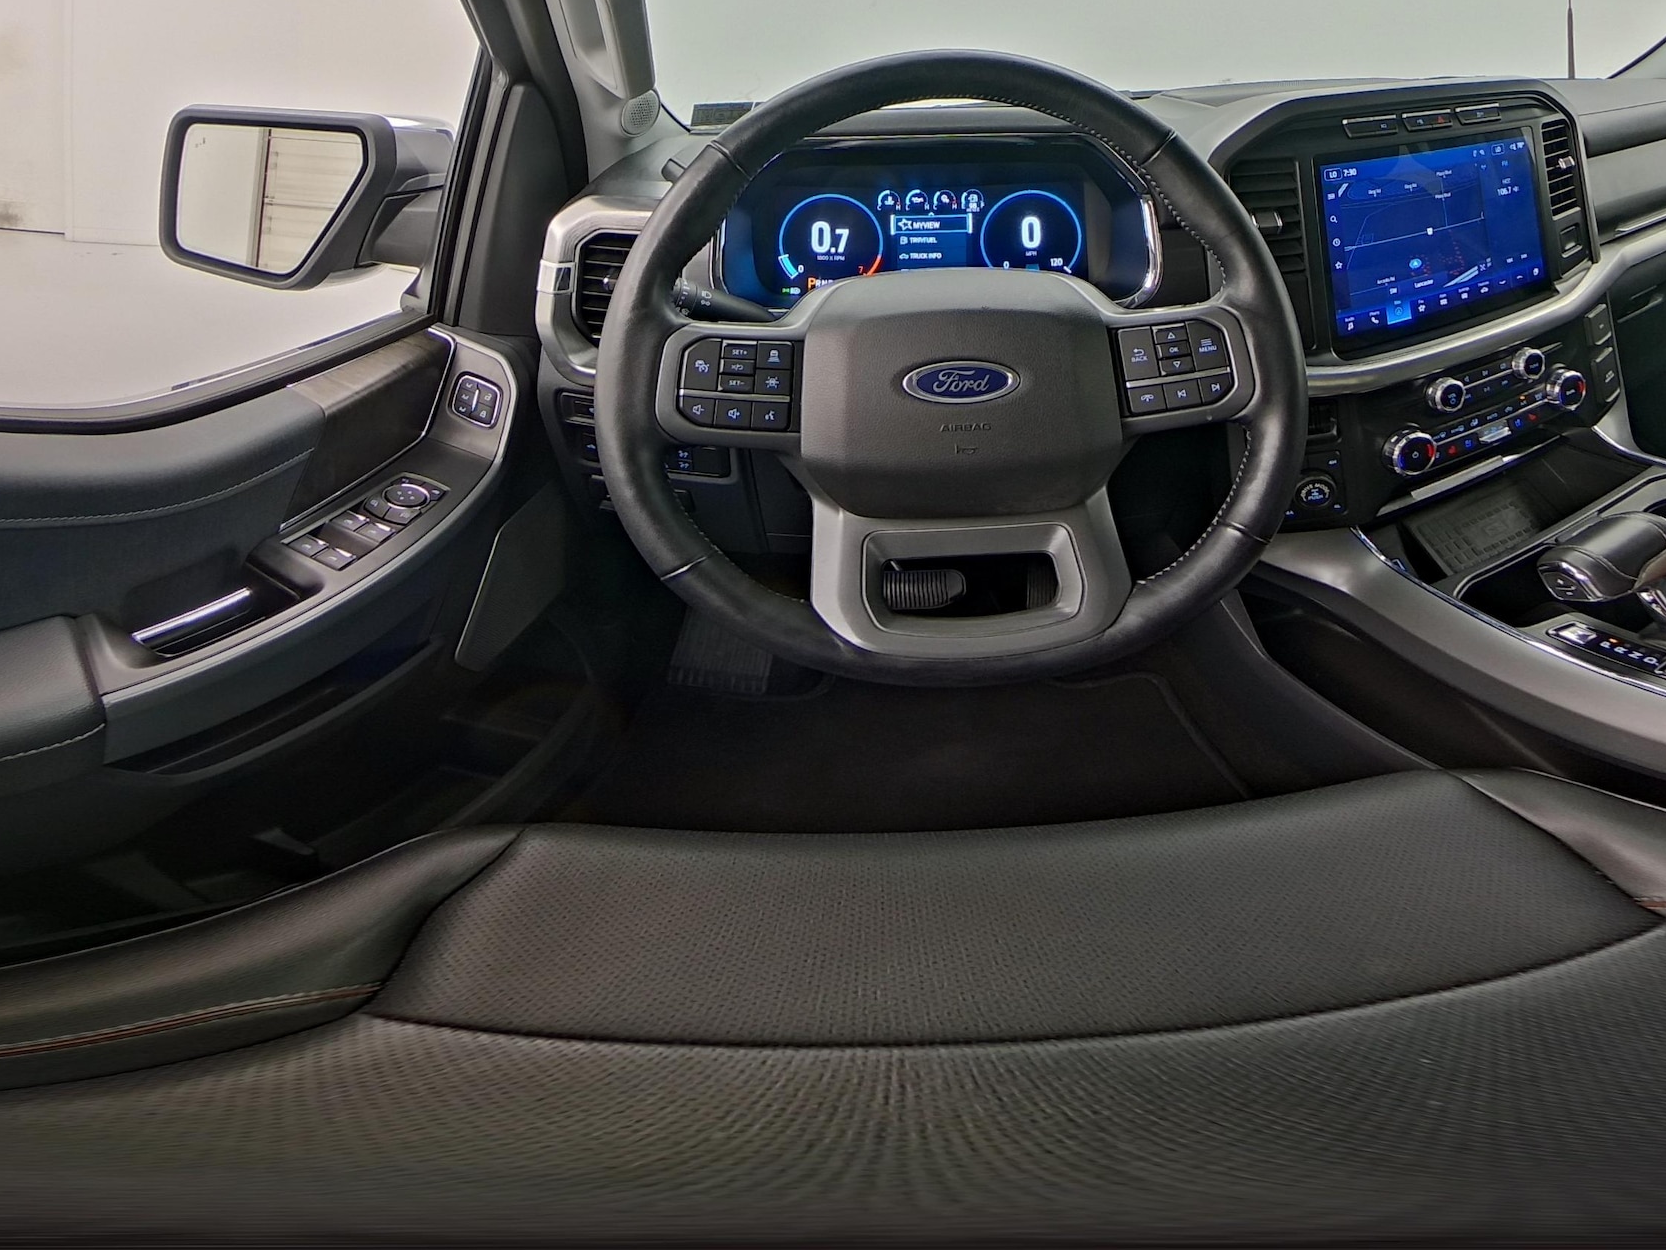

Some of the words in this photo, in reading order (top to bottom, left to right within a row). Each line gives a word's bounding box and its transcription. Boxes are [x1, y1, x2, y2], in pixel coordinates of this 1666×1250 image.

[913, 221, 940, 229] MYVIEW
[811, 220, 849, 254] 0.7
[1021, 216, 1041, 249] 0
[1003, 260, 1010, 269] 0
[1050, 257, 1063, 267] 120
[797, 264, 804, 273] 0
[1198, 345, 1217, 353] MENU
[1131, 355, 1148, 363] BACK
[933, 370, 990, 392] Ford
[940, 422, 992, 432] AIRBAG
